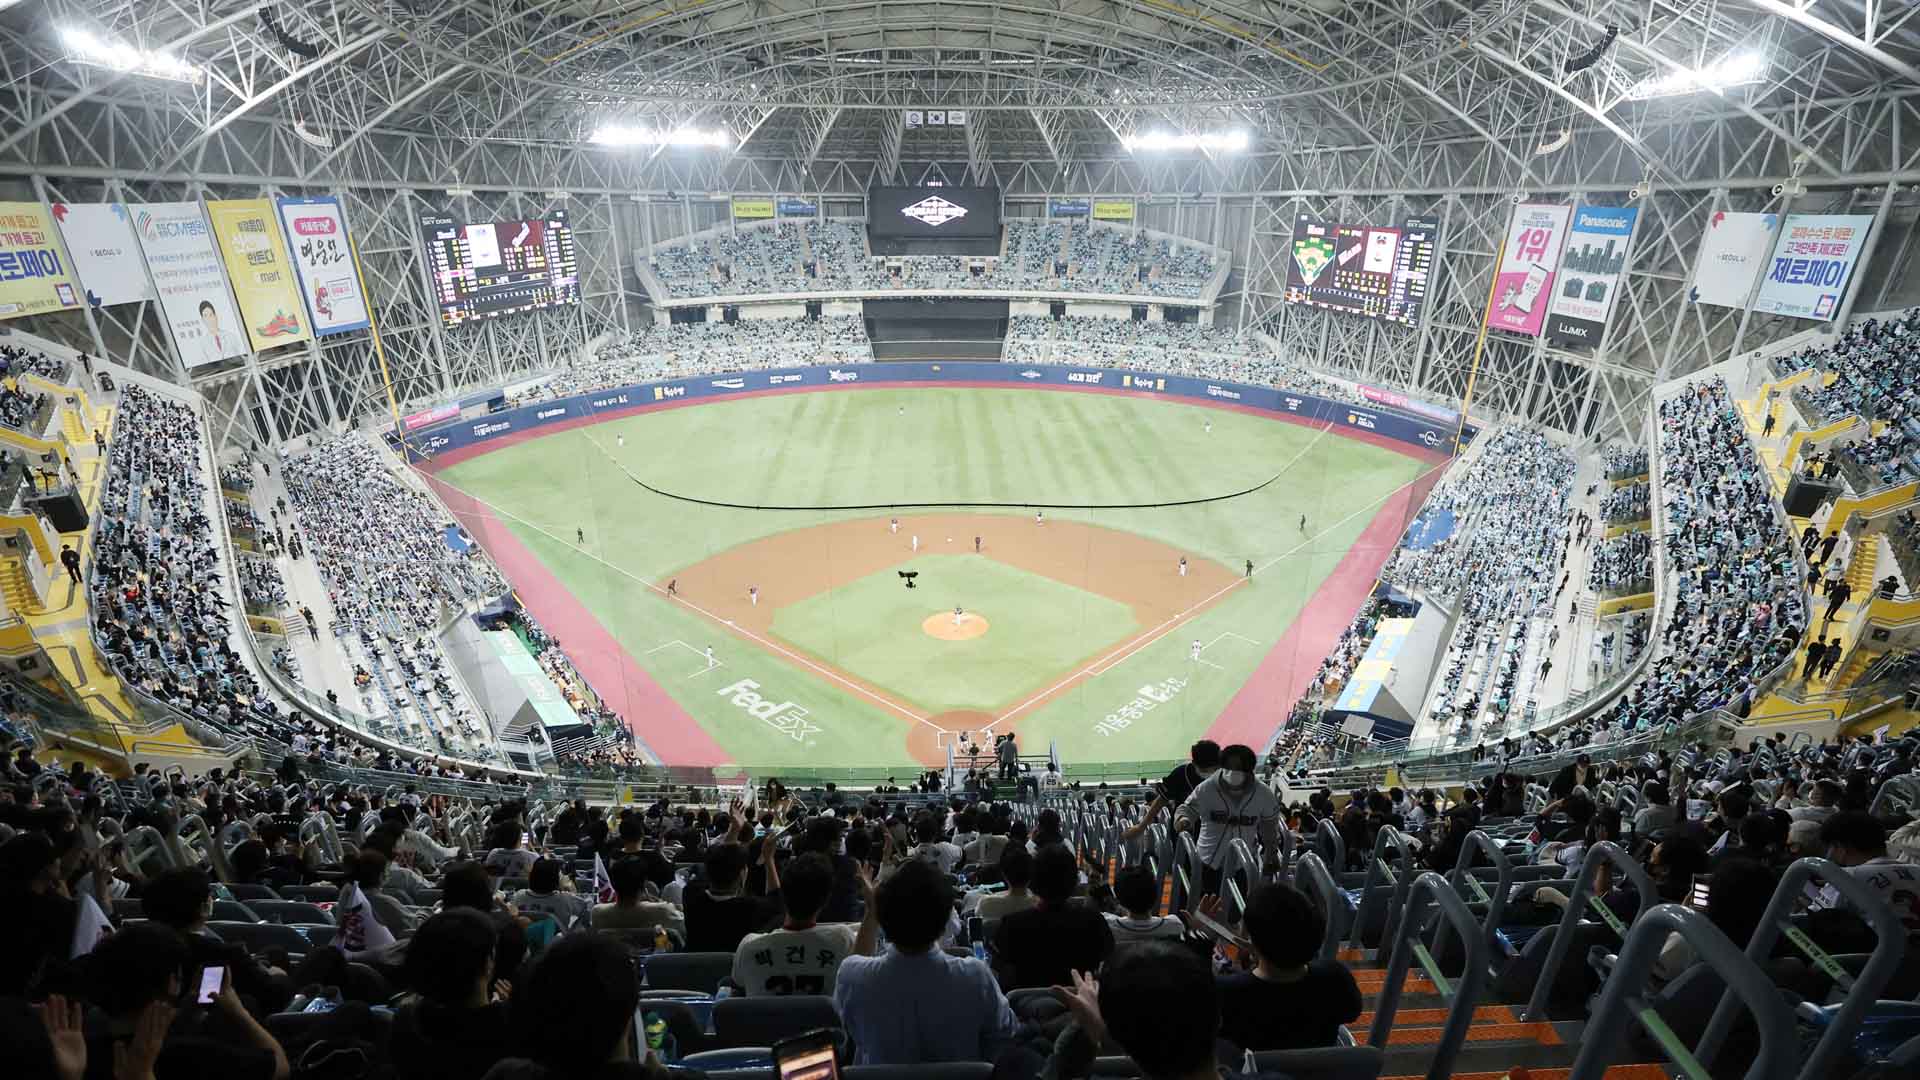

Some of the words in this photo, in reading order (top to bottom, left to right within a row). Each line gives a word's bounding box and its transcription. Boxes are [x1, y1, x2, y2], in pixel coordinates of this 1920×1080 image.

[1580, 213, 1628, 230] Panasonic
[1515, 228, 1552, 263] 1위
[1784, 242, 1818, 256] 고객만족
[0, 248, 64, 282] 로페이
[1769, 257, 1848, 288] 제로페이
[1559, 322, 1588, 338] LUMIX
